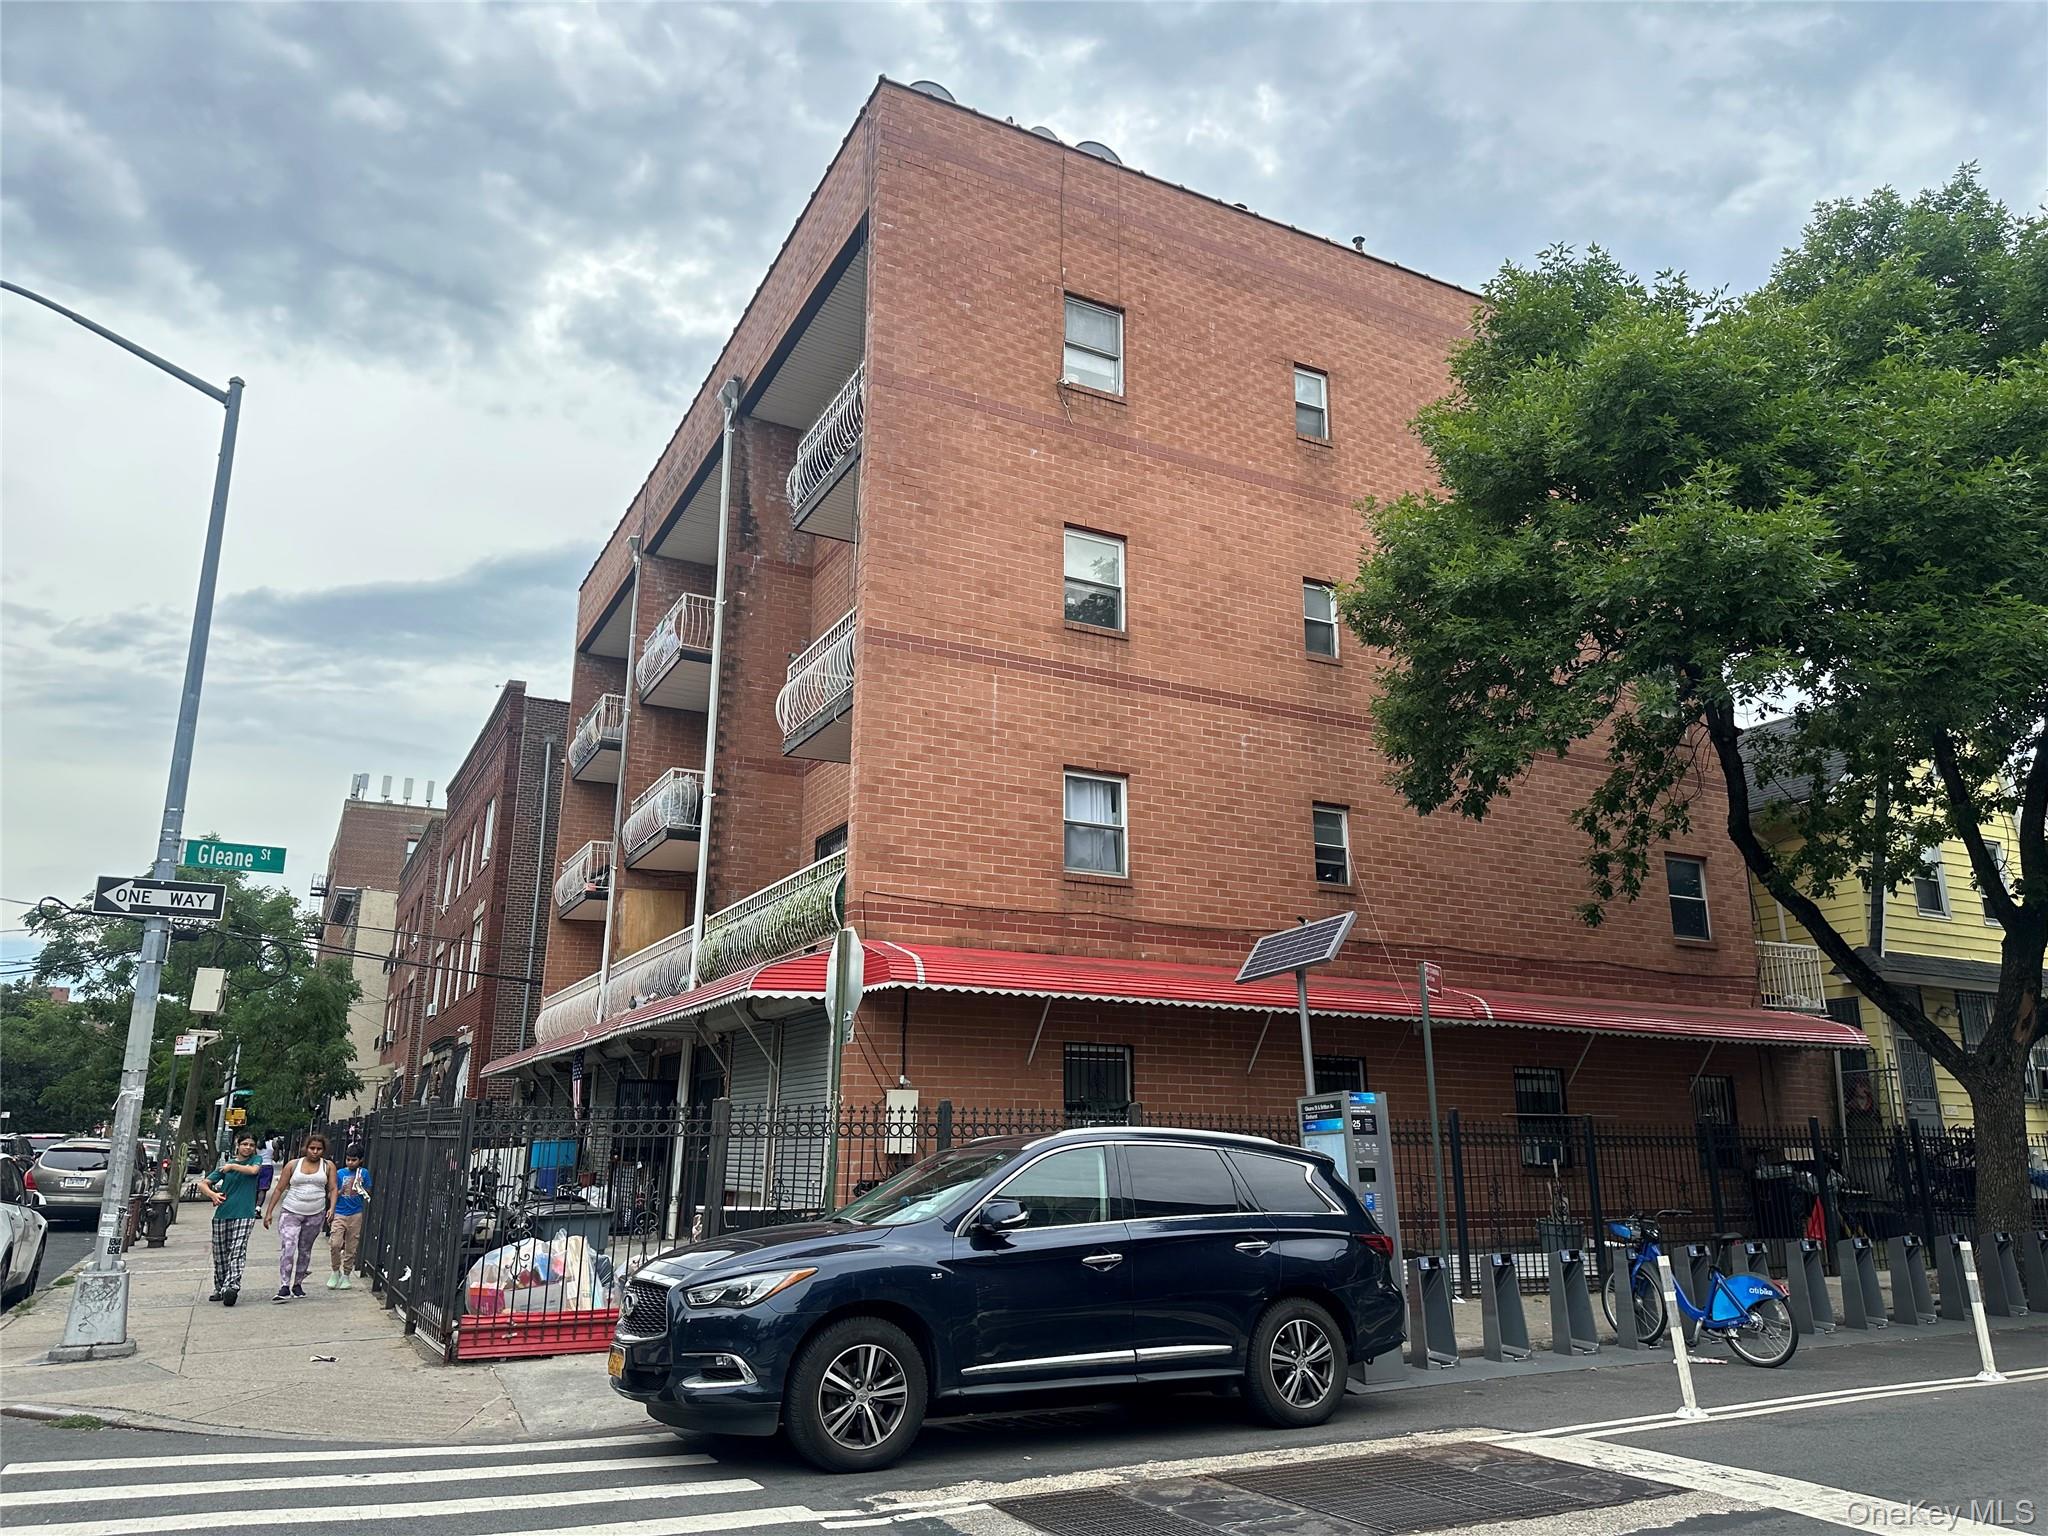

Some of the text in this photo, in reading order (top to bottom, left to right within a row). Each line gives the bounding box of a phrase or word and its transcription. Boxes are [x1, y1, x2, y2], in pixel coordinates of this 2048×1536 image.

[197, 844, 272, 868] Gleane St
[115, 888, 208, 908] ONE WAY
